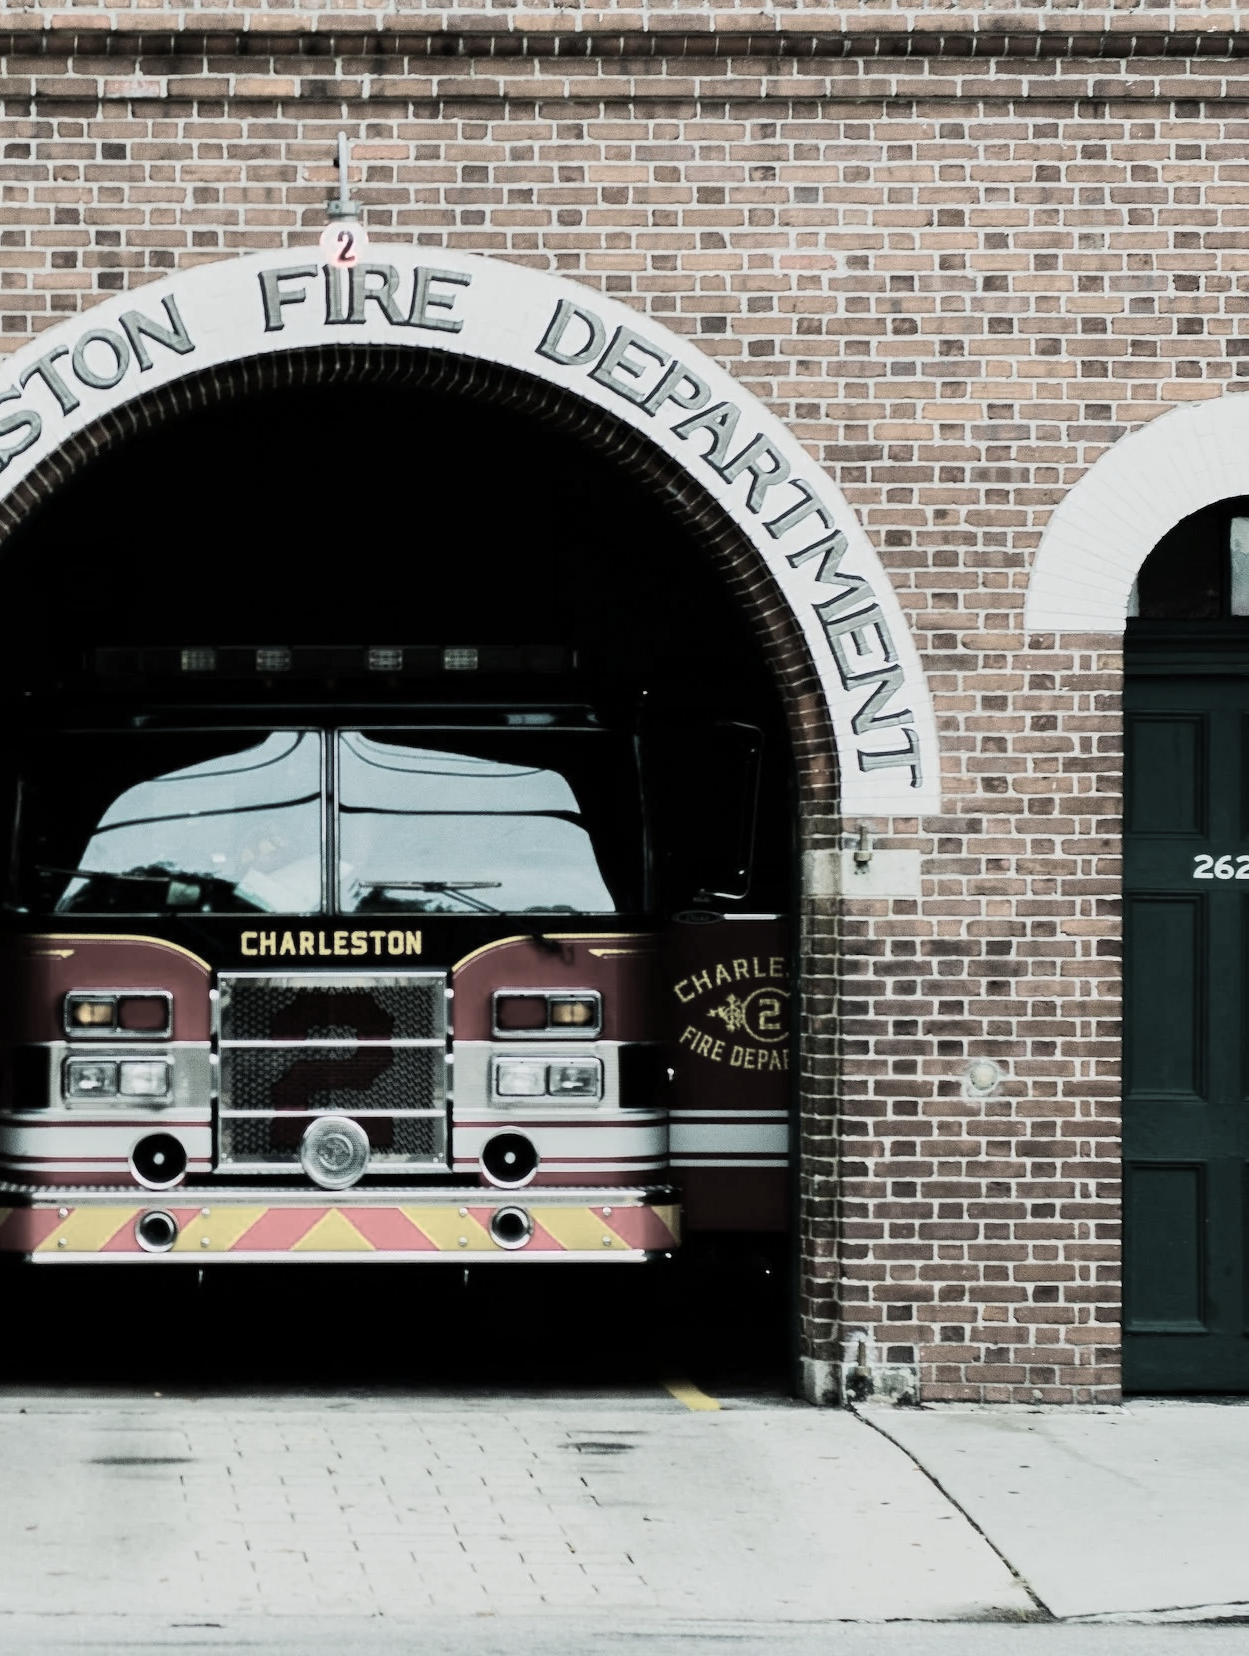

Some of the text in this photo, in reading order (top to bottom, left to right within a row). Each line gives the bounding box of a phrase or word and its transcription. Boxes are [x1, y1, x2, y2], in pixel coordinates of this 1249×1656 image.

[337, 230, 356, 263] 2
[257, 263, 472, 334] FIRE
[534, 298, 924, 789] DEPARTMENT
[1192, 853, 1249, 880] 262
[240, 930, 422, 956] CHARLESTON
[673, 956, 789, 1003] CHARLE
[758, 998, 782, 1031] 2
[678, 1024, 726, 1062] FIRE
